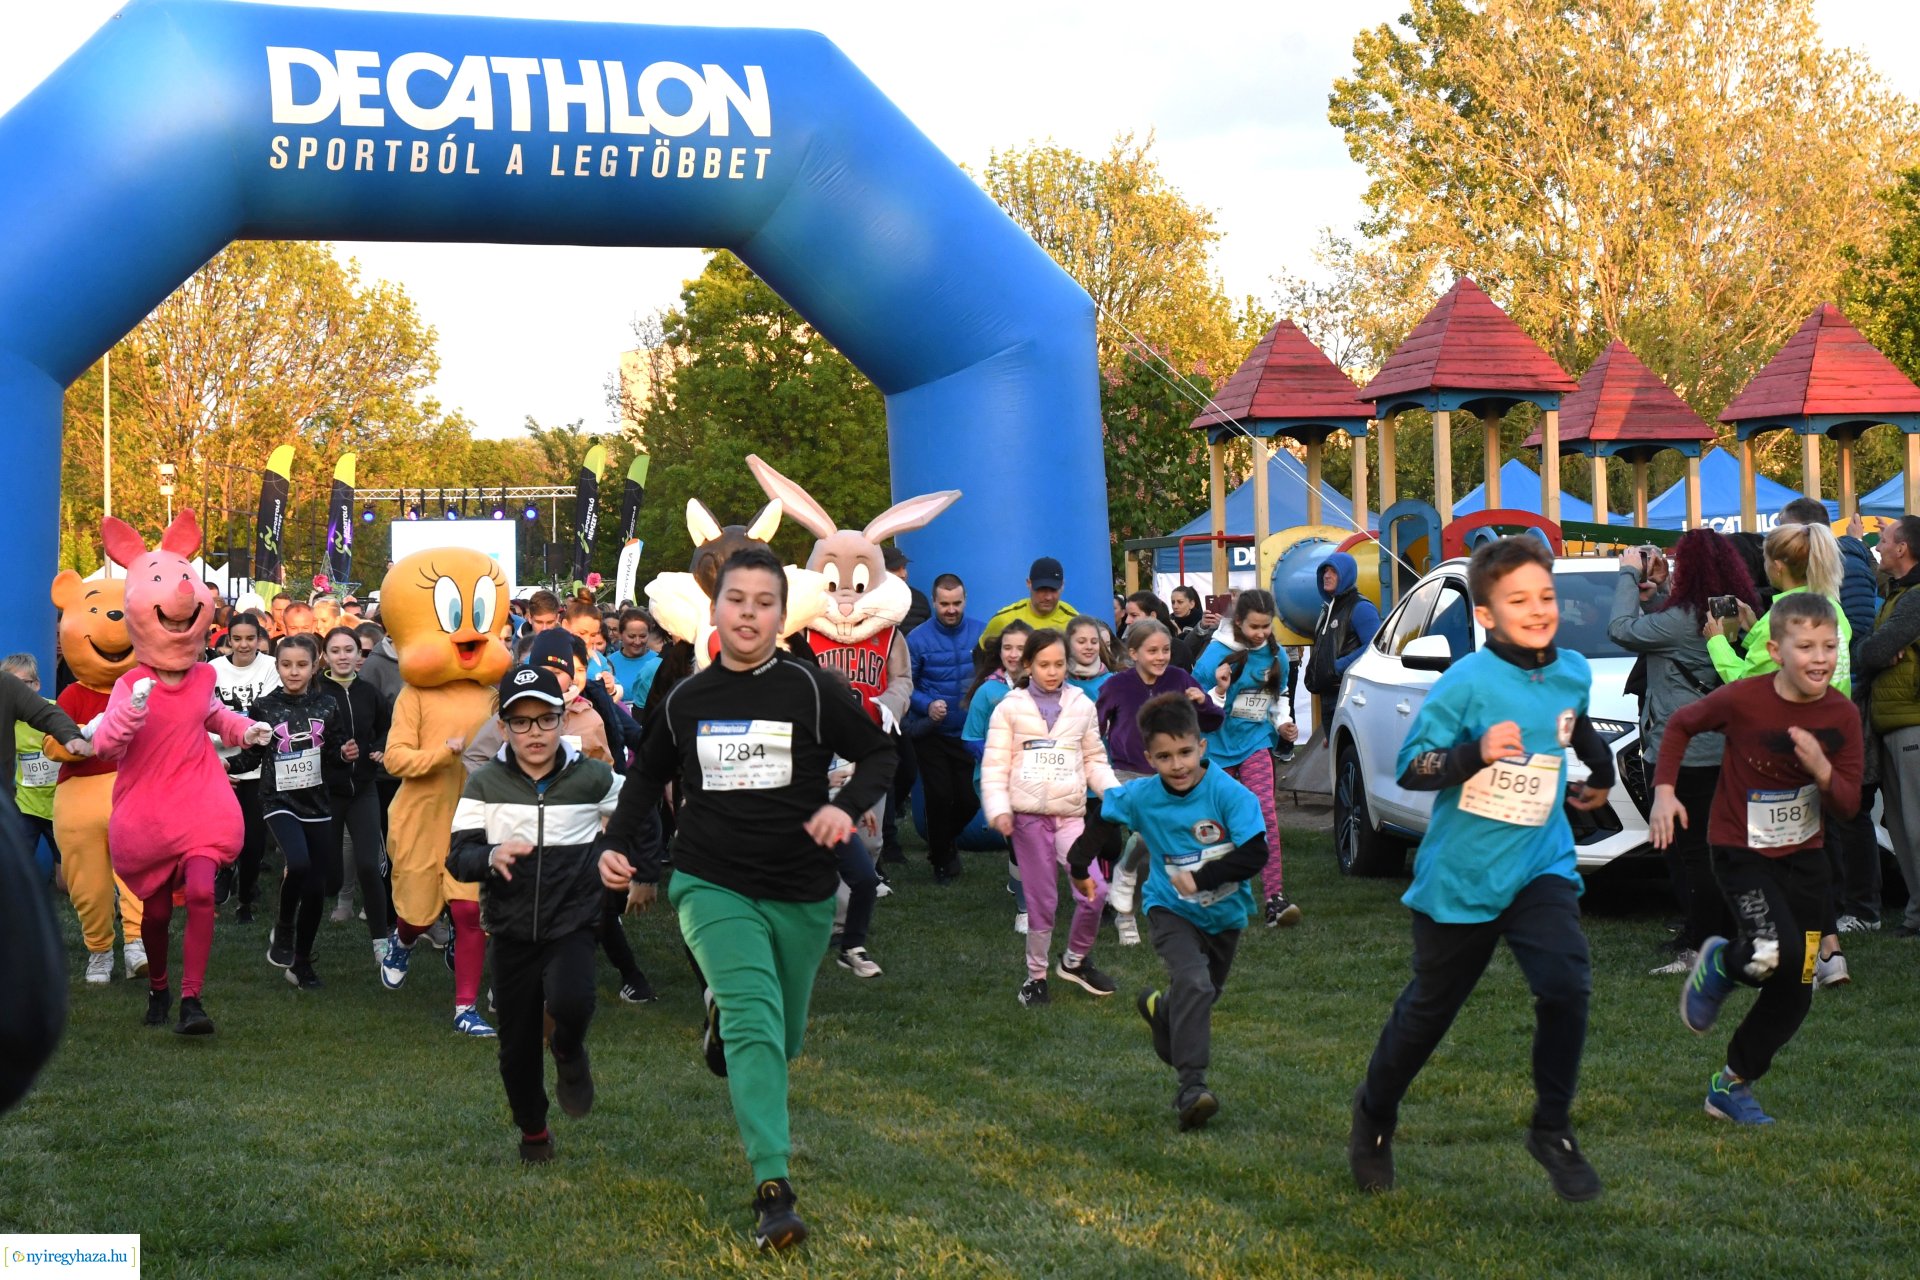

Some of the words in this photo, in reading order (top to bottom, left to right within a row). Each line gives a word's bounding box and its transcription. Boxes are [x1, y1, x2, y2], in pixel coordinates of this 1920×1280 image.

[266, 46, 771, 137] DECATHLON
[269, 133, 480, 175] SPORTBÓL
[505, 144, 524, 175] A
[550, 139, 771, 179] LEGTÖBBET
[587, 513, 598, 540] NEMZET
[1245, 696, 1267, 708] 1577
[718, 743, 766, 762] 1284
[1035, 752, 1065, 765] 1586
[28, 761, 49, 772] 1616
[286, 761, 313, 774] 1493
[1489, 768, 1541, 795] 1589
[1769, 802, 1810, 824] 1587
